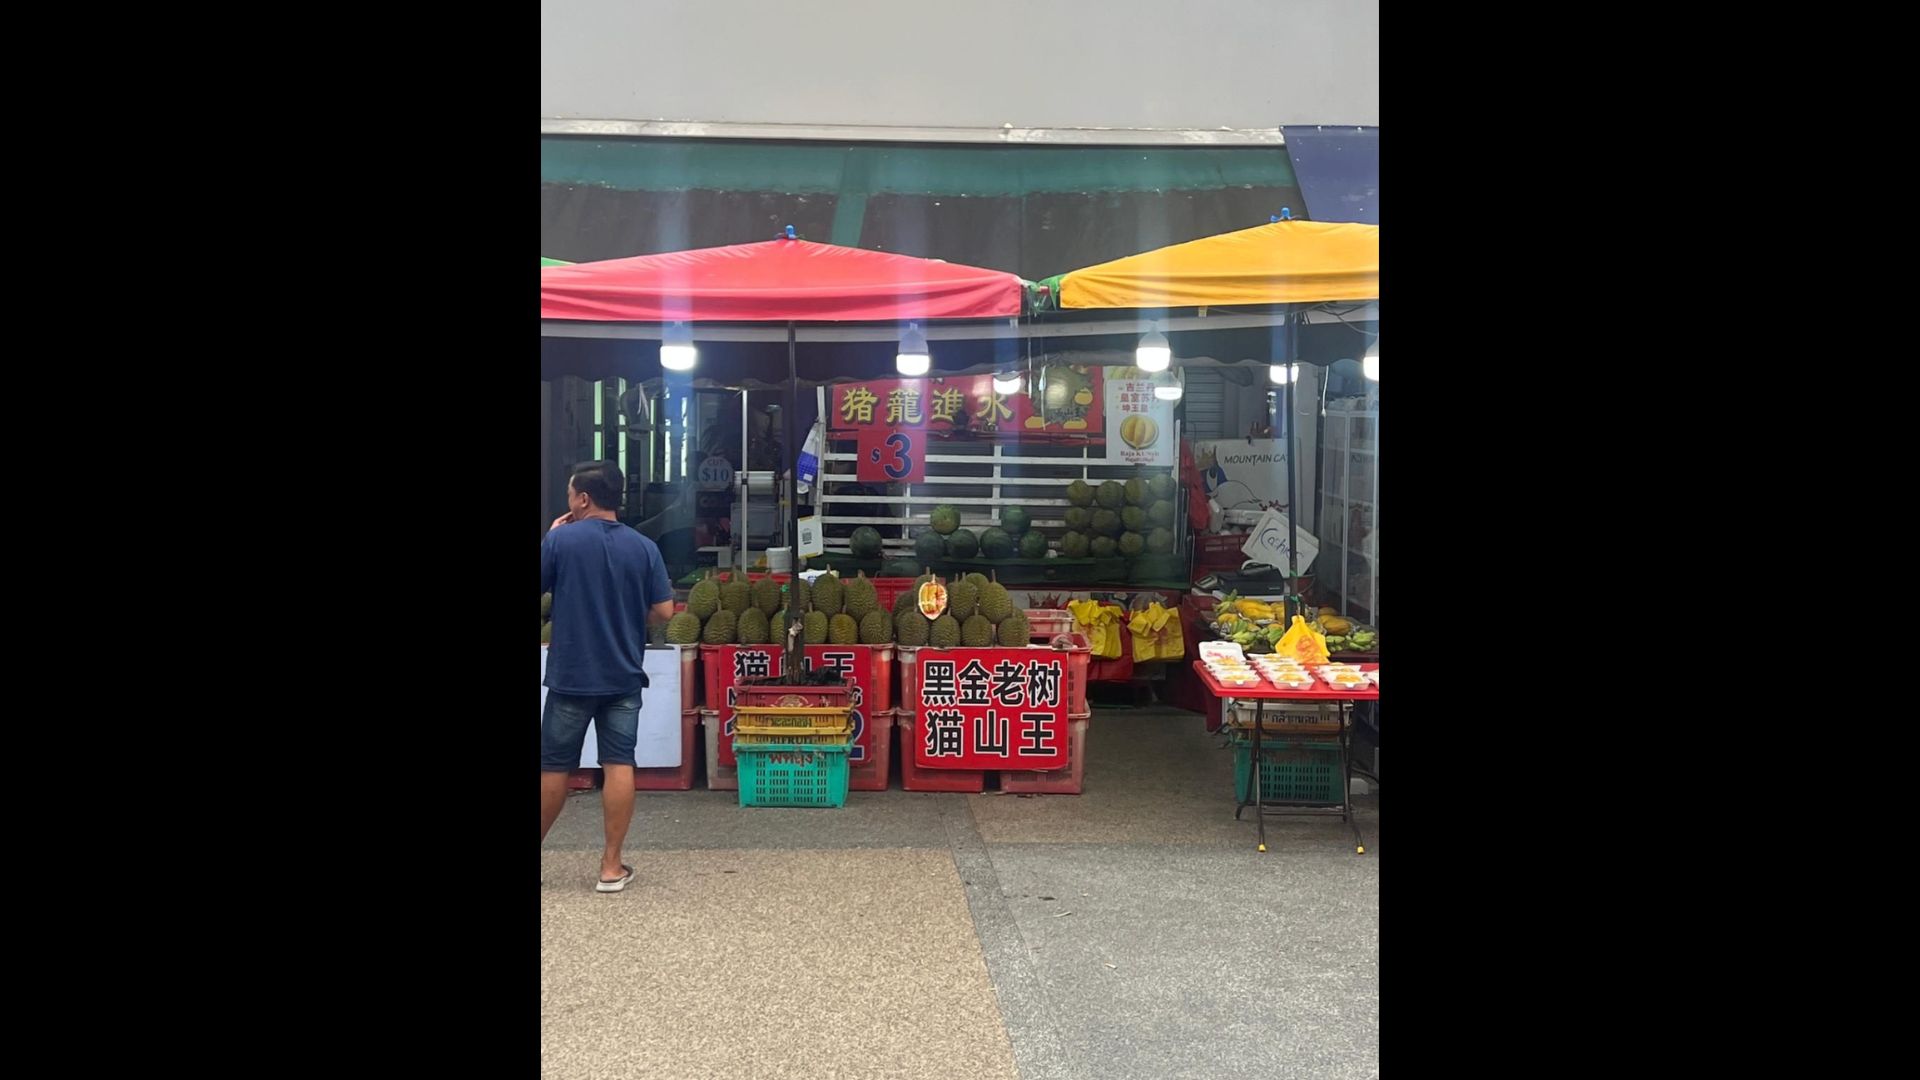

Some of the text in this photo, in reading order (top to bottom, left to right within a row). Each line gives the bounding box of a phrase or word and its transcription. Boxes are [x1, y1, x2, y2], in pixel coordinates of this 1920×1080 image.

[702, 467, 729, 482] $10
[1224, 453, 1289, 466] MOUNTAIN CA
[922, 660, 1062, 707] 黑金老树
[925, 709, 1057, 757] 猫山王
